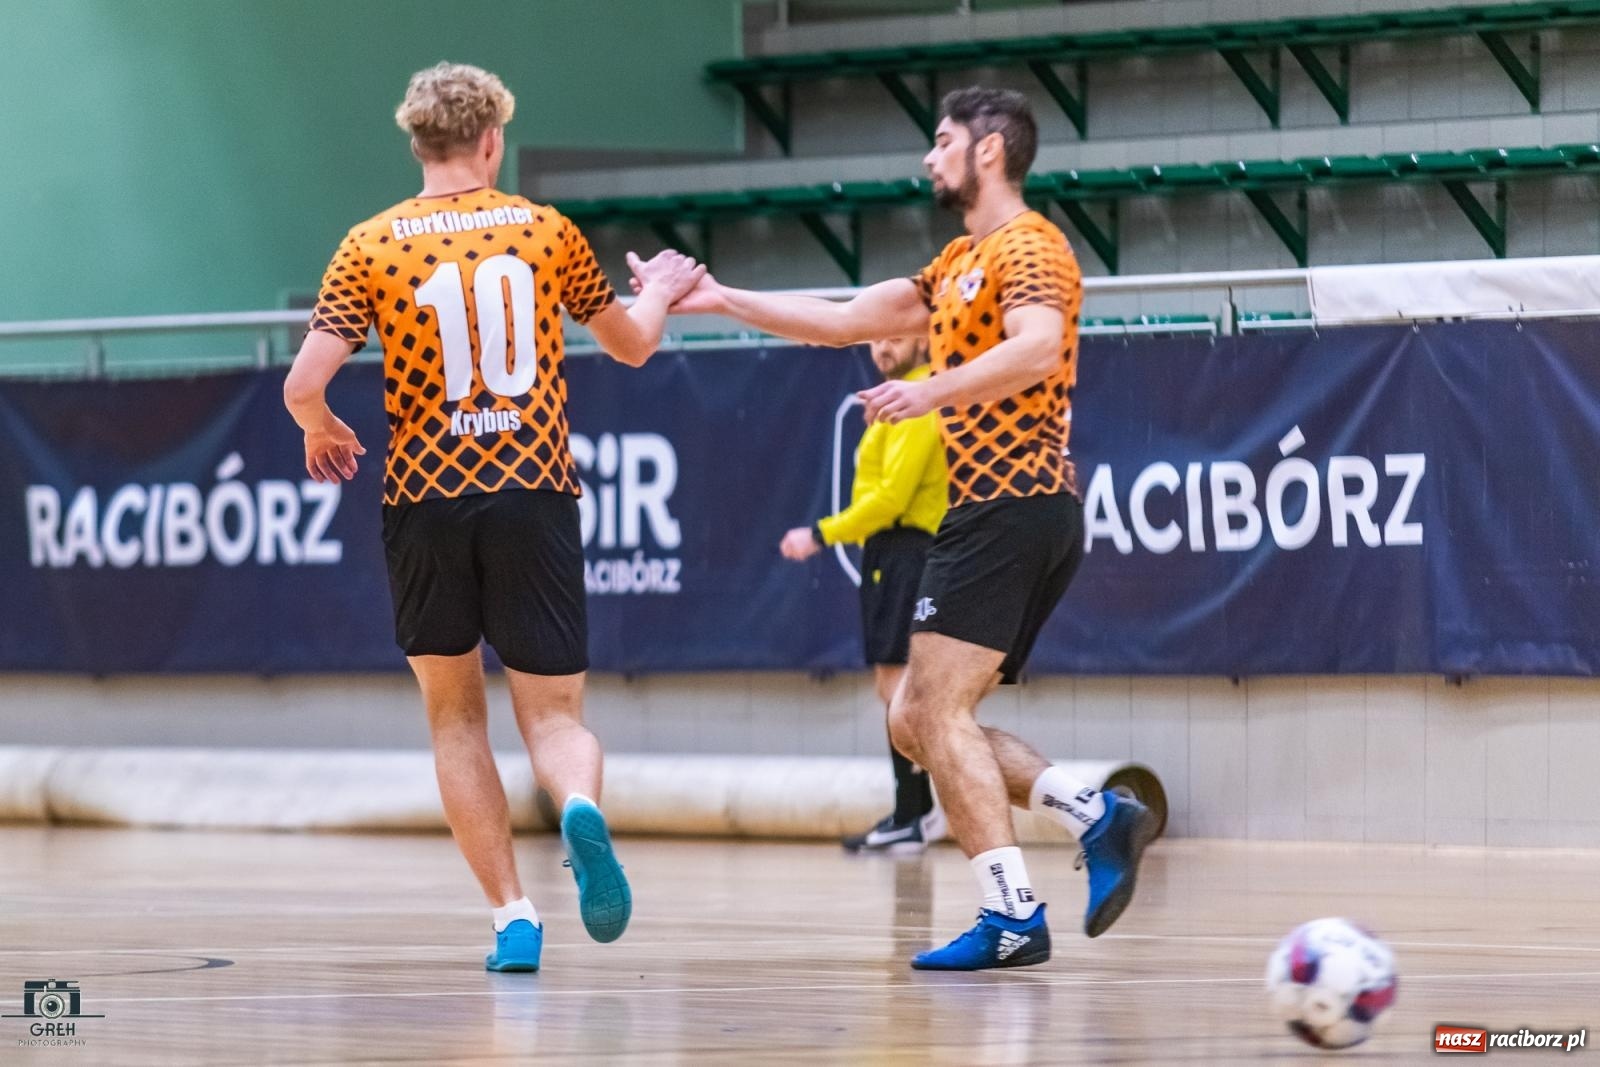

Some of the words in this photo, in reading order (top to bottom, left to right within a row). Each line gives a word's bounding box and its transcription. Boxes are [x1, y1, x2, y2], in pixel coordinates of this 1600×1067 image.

[413, 254, 538, 402] 10
[450, 407, 522, 437] Krybus
[25, 451, 343, 569] RACIBÓRZ
[570, 431, 682, 550] SiR
[1083, 424, 1427, 556] ACIBÓRZ
[584, 550, 682, 594] ACIBÓRZ
